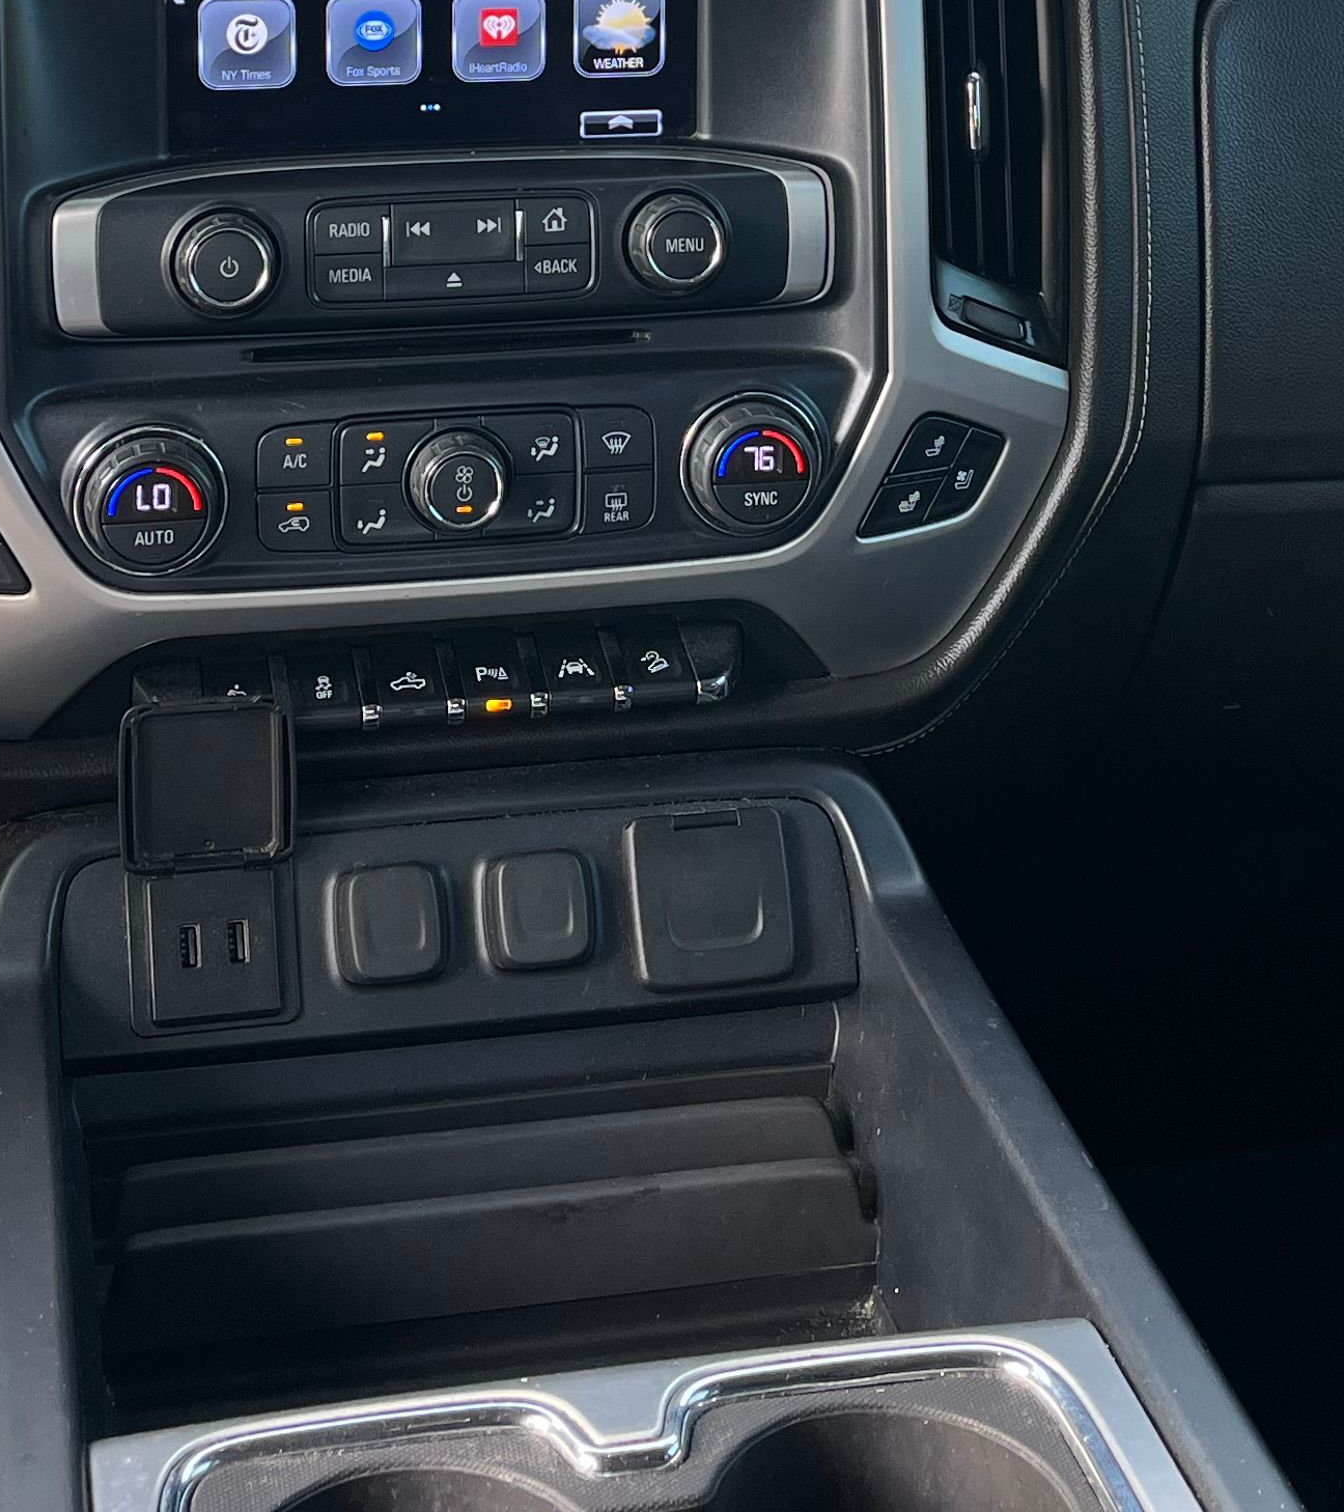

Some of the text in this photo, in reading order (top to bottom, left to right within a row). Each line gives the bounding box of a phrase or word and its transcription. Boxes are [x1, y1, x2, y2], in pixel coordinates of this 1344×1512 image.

[593, 57, 644, 70] WEATHER
[221, 69, 272, 81] NY Times
[346, 65, 401, 78] Fox Sports
[329, 222, 370, 238] RADIO
[665, 237, 705, 253] MENU
[542, 259, 578, 275] BACK
[329, 268, 372, 284] MEDIA
[283, 454, 307, 468] A/C
[744, 445, 774, 471] 76
[744, 491, 778, 506] SYNC
[604, 511, 629, 522] REAR
[135, 530, 174, 546] AUTO
[316, 690, 333, 700] OFF
